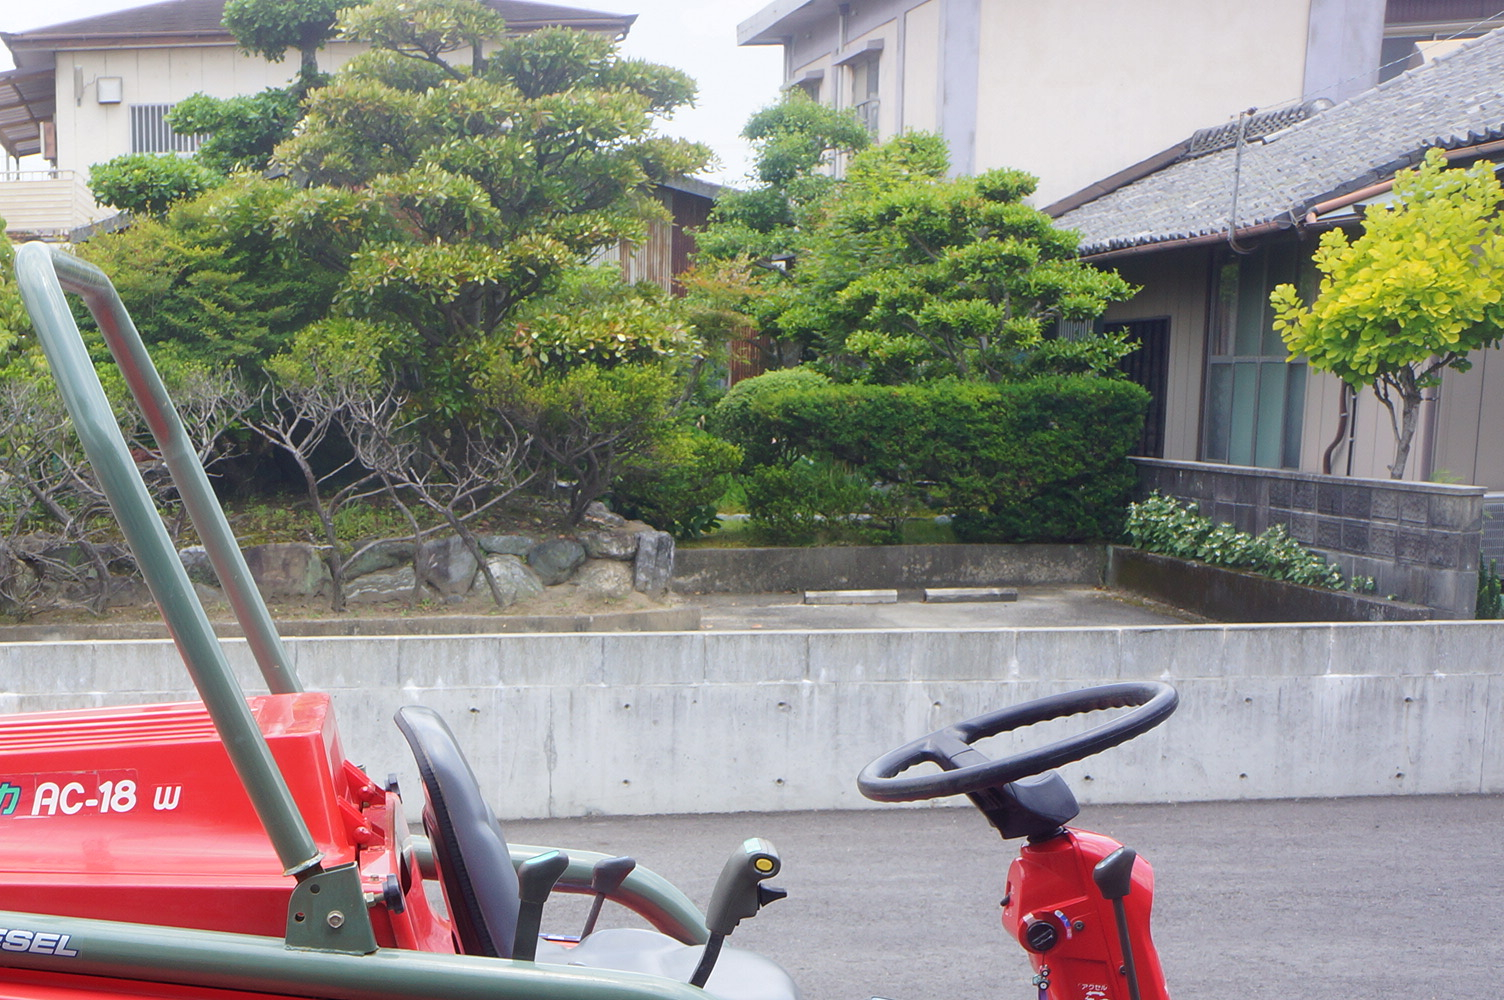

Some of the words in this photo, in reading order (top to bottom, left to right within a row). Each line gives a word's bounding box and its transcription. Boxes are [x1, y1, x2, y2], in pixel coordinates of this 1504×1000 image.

[31, 779, 137, 816] AC-18
[1081, 983, 1108, 991] アクセル
